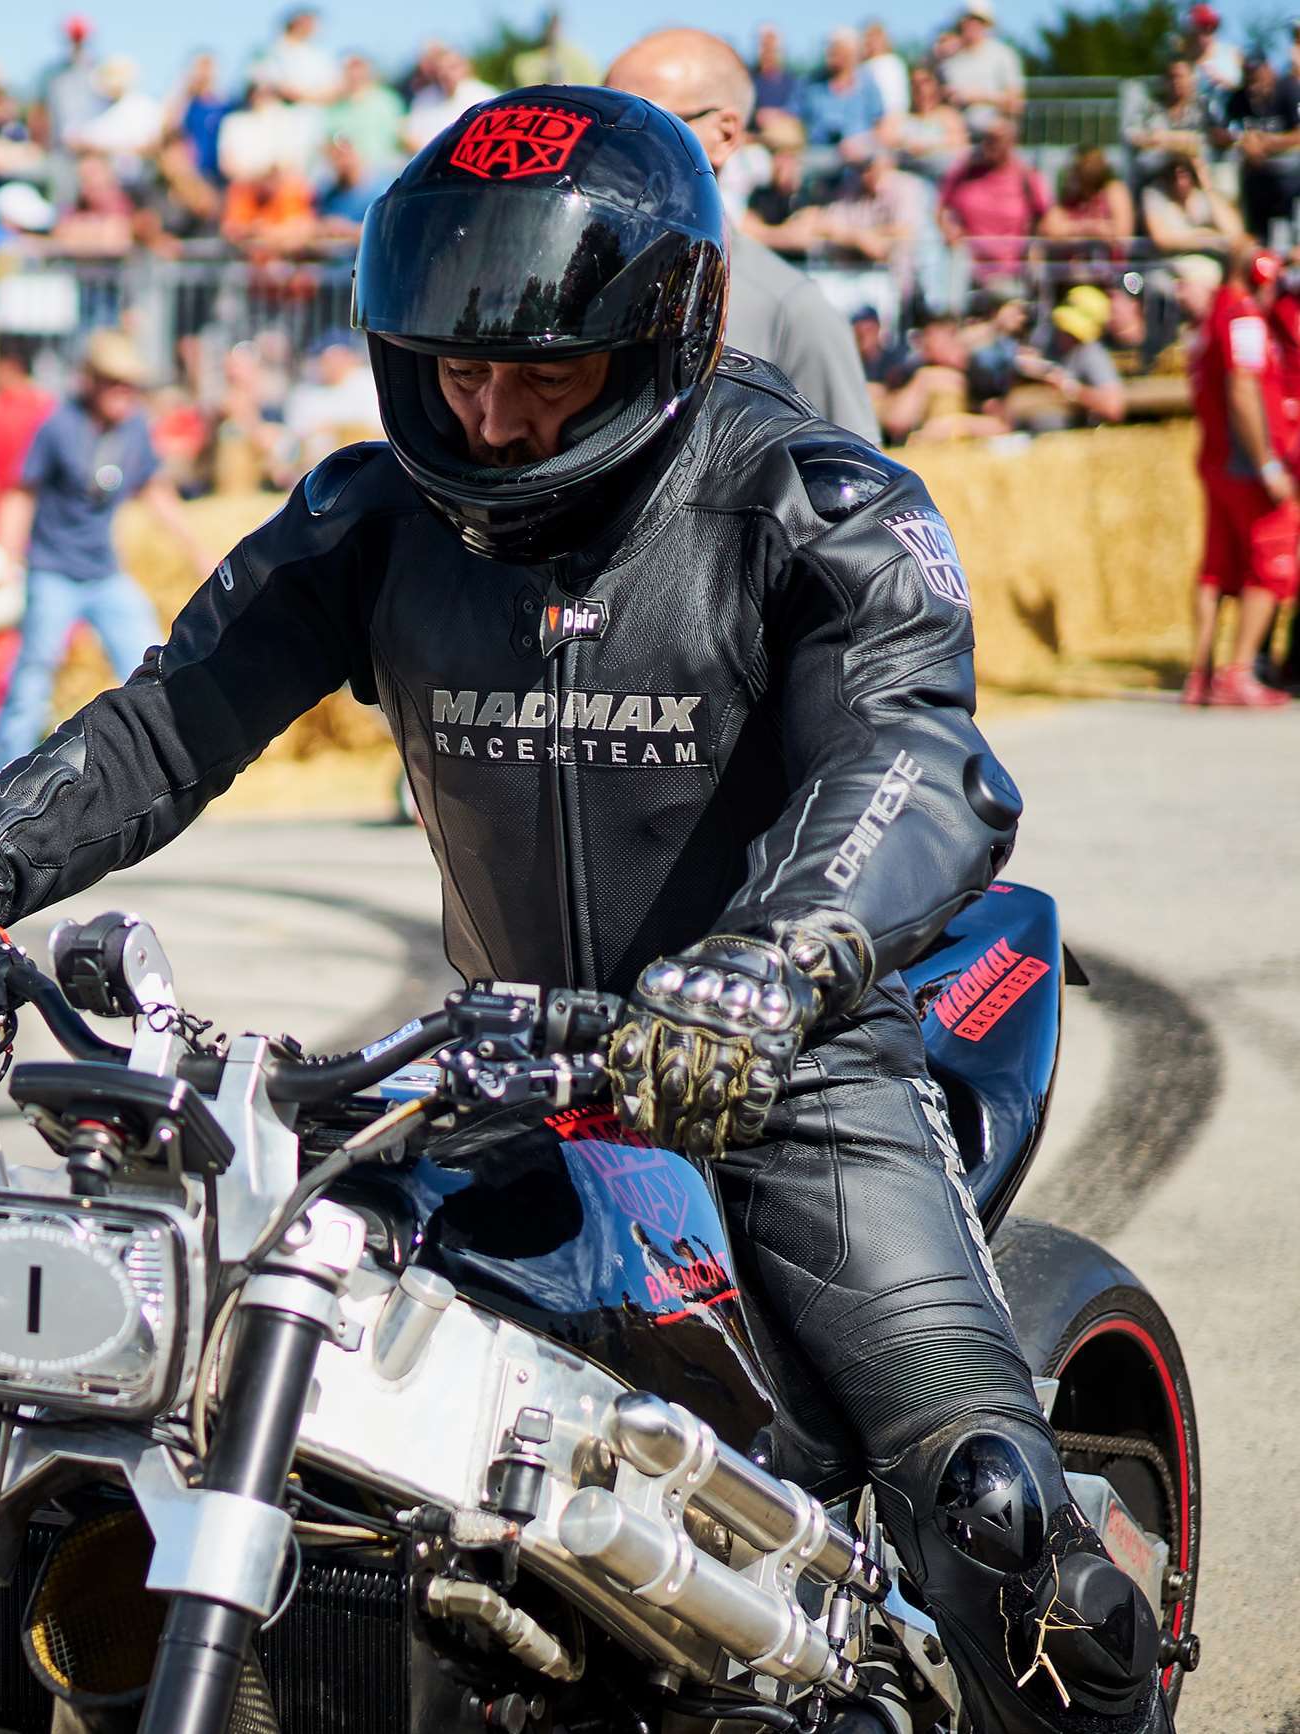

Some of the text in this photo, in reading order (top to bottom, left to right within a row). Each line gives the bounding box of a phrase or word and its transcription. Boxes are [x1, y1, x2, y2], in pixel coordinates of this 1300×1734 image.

[471, 113, 575, 141] MAD
[460, 139, 558, 172] MAX
[882, 510, 922, 527] RACE
[433, 690, 701, 732] MADMAX
[435, 732, 697, 764] RACE TEAM
[824, 749, 923, 889] DAINESE
[933, 937, 1022, 1029] MADMAX
[962, 1000, 1004, 1036] RACE
[1004, 960, 1043, 993] TEAM
[610, 1166, 680, 1226] MAX
[644, 1252, 731, 1305] BREMONT
